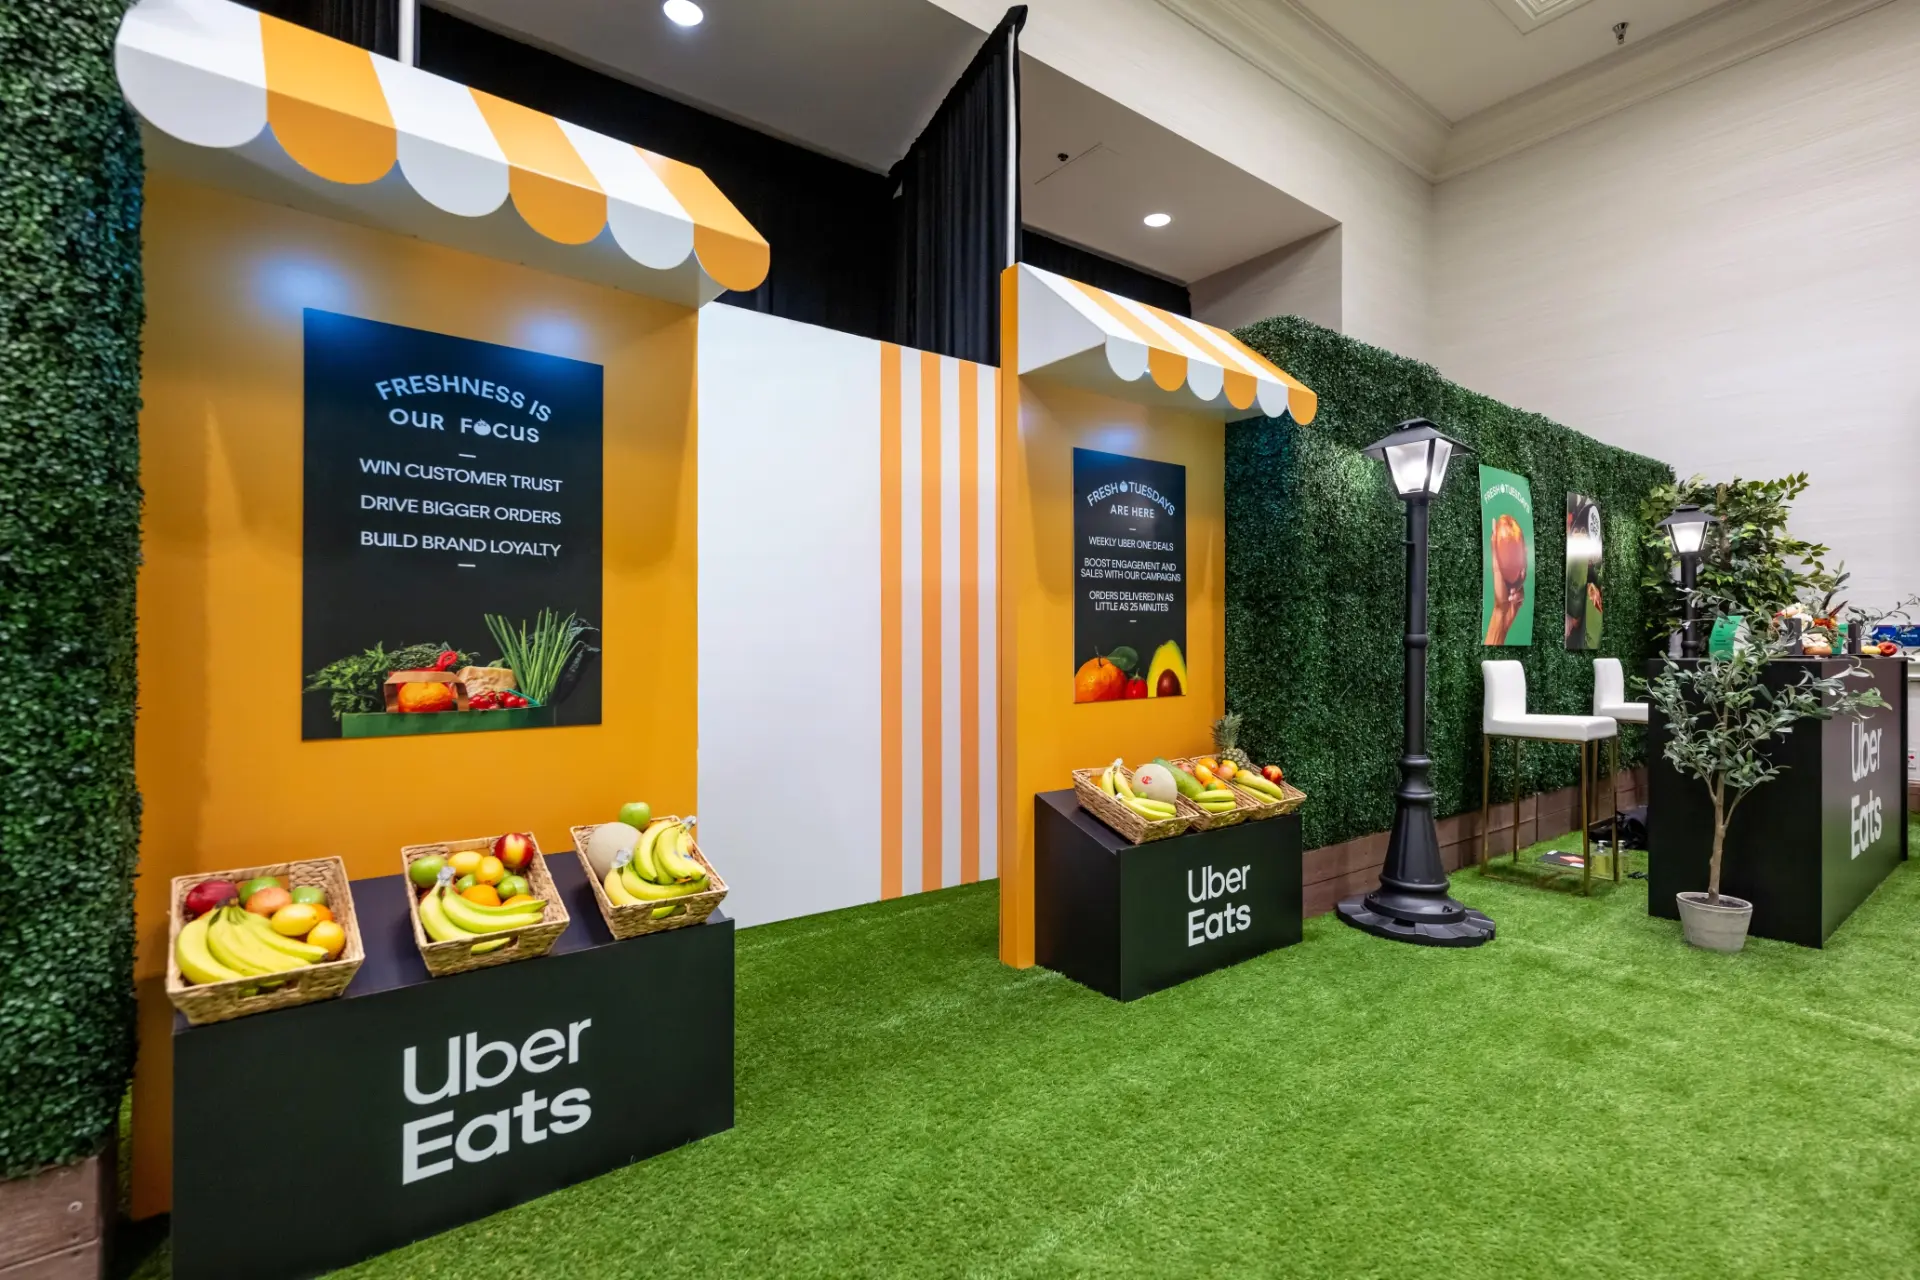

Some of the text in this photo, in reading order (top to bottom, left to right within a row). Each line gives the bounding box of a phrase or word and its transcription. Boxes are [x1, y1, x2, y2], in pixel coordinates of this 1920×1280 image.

[375, 374, 552, 422] FRESHNESS IS
[389, 408, 445, 431] OUR
[359, 457, 563, 492] WIN CUSTOMER TRUST
[360, 494, 562, 525] DRIVE BIGGER ORDERS
[1087, 481, 1175, 516] FRESH TUESDAYS
[1110, 504, 1155, 519] ARE HERE
[360, 531, 562, 557] BUILD BRAND LOYALTY
[1088, 535, 1174, 552] WEEKLY UBER ONE DEALS
[1080, 568, 1182, 582] SALES WITH OUR CAMPAIGNS
[1084, 557, 1177, 572] BOOST ENGAGEMENT AND
[1089, 590, 1174, 602] ORDERS DELIVERED IN AS
[1095, 601, 1169, 612] LITTLE AS 25 MINUTES
[1851, 721, 1882, 782] Uber
[1851, 789, 1882, 861] Eats
[1188, 864, 1251, 903] Uber
[1188, 902, 1251, 947] Eats
[403, 1018, 592, 1105] Uber
[402, 1088, 592, 1185] Eats
